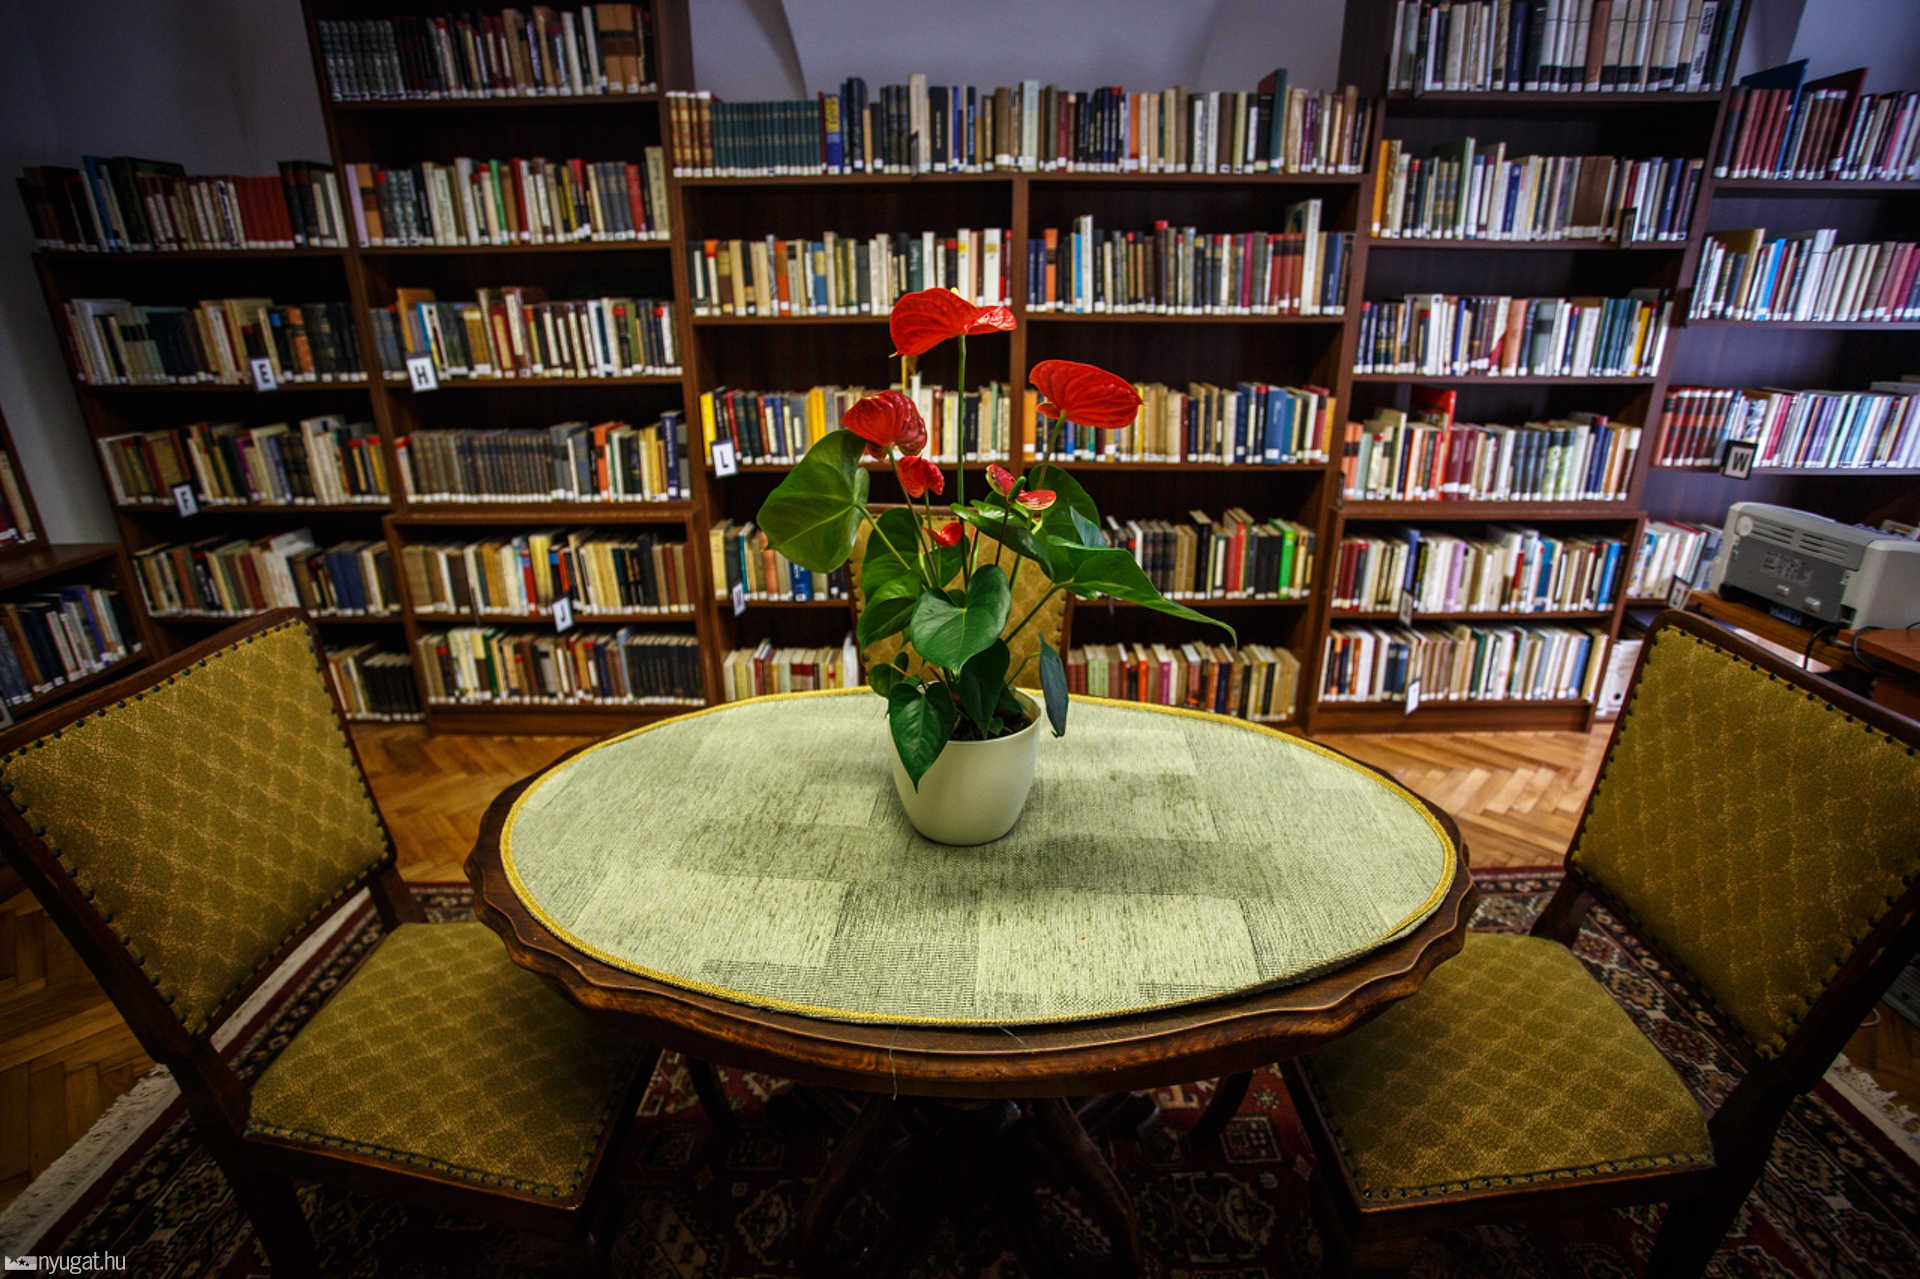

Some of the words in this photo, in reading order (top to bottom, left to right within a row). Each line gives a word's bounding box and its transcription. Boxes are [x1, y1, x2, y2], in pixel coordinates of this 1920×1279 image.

[259, 363, 270, 383] E
[414, 365, 429, 386] H
[720, 450, 729, 468] L
[1731, 451, 1750, 472] W
